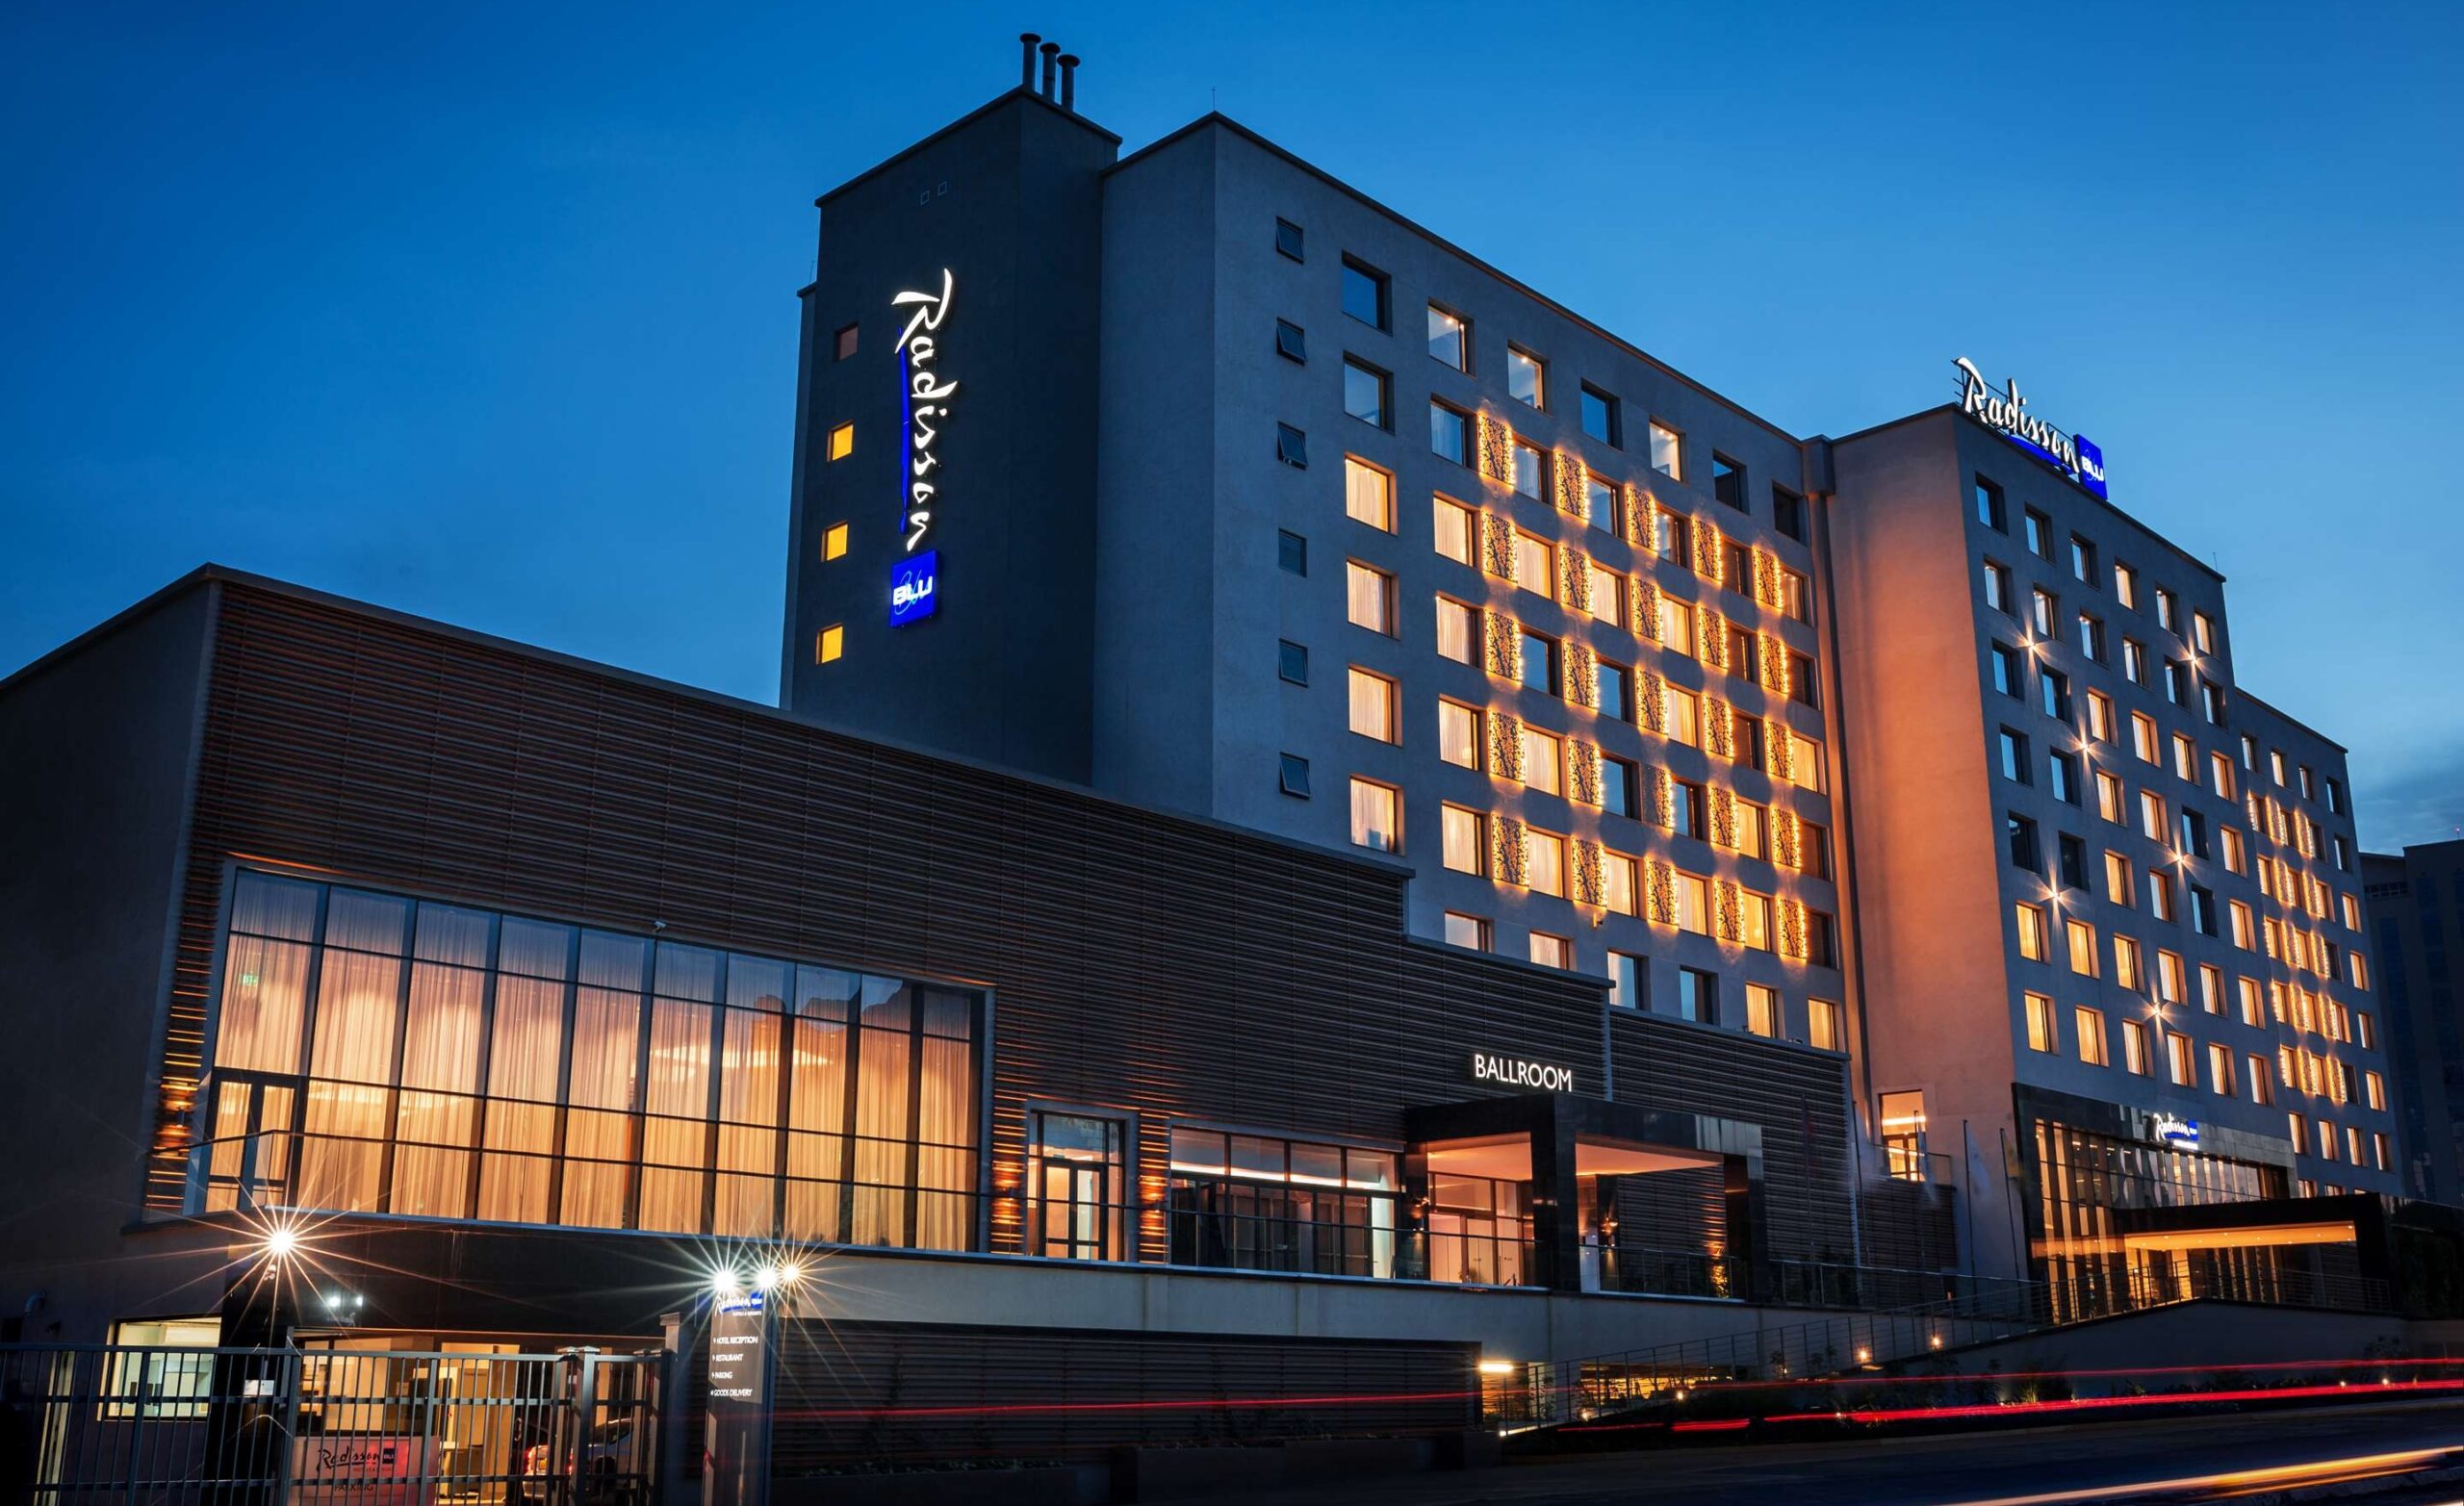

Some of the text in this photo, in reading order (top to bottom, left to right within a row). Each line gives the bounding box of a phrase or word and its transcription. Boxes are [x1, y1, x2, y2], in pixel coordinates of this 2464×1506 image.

[891, 268, 959, 606] Radisson BLU
[1955, 356, 2105, 481] Radisson BLU
[1475, 1054, 1573, 1092] BALLROOM
[714, 1389, 730, 1397] GOODS
